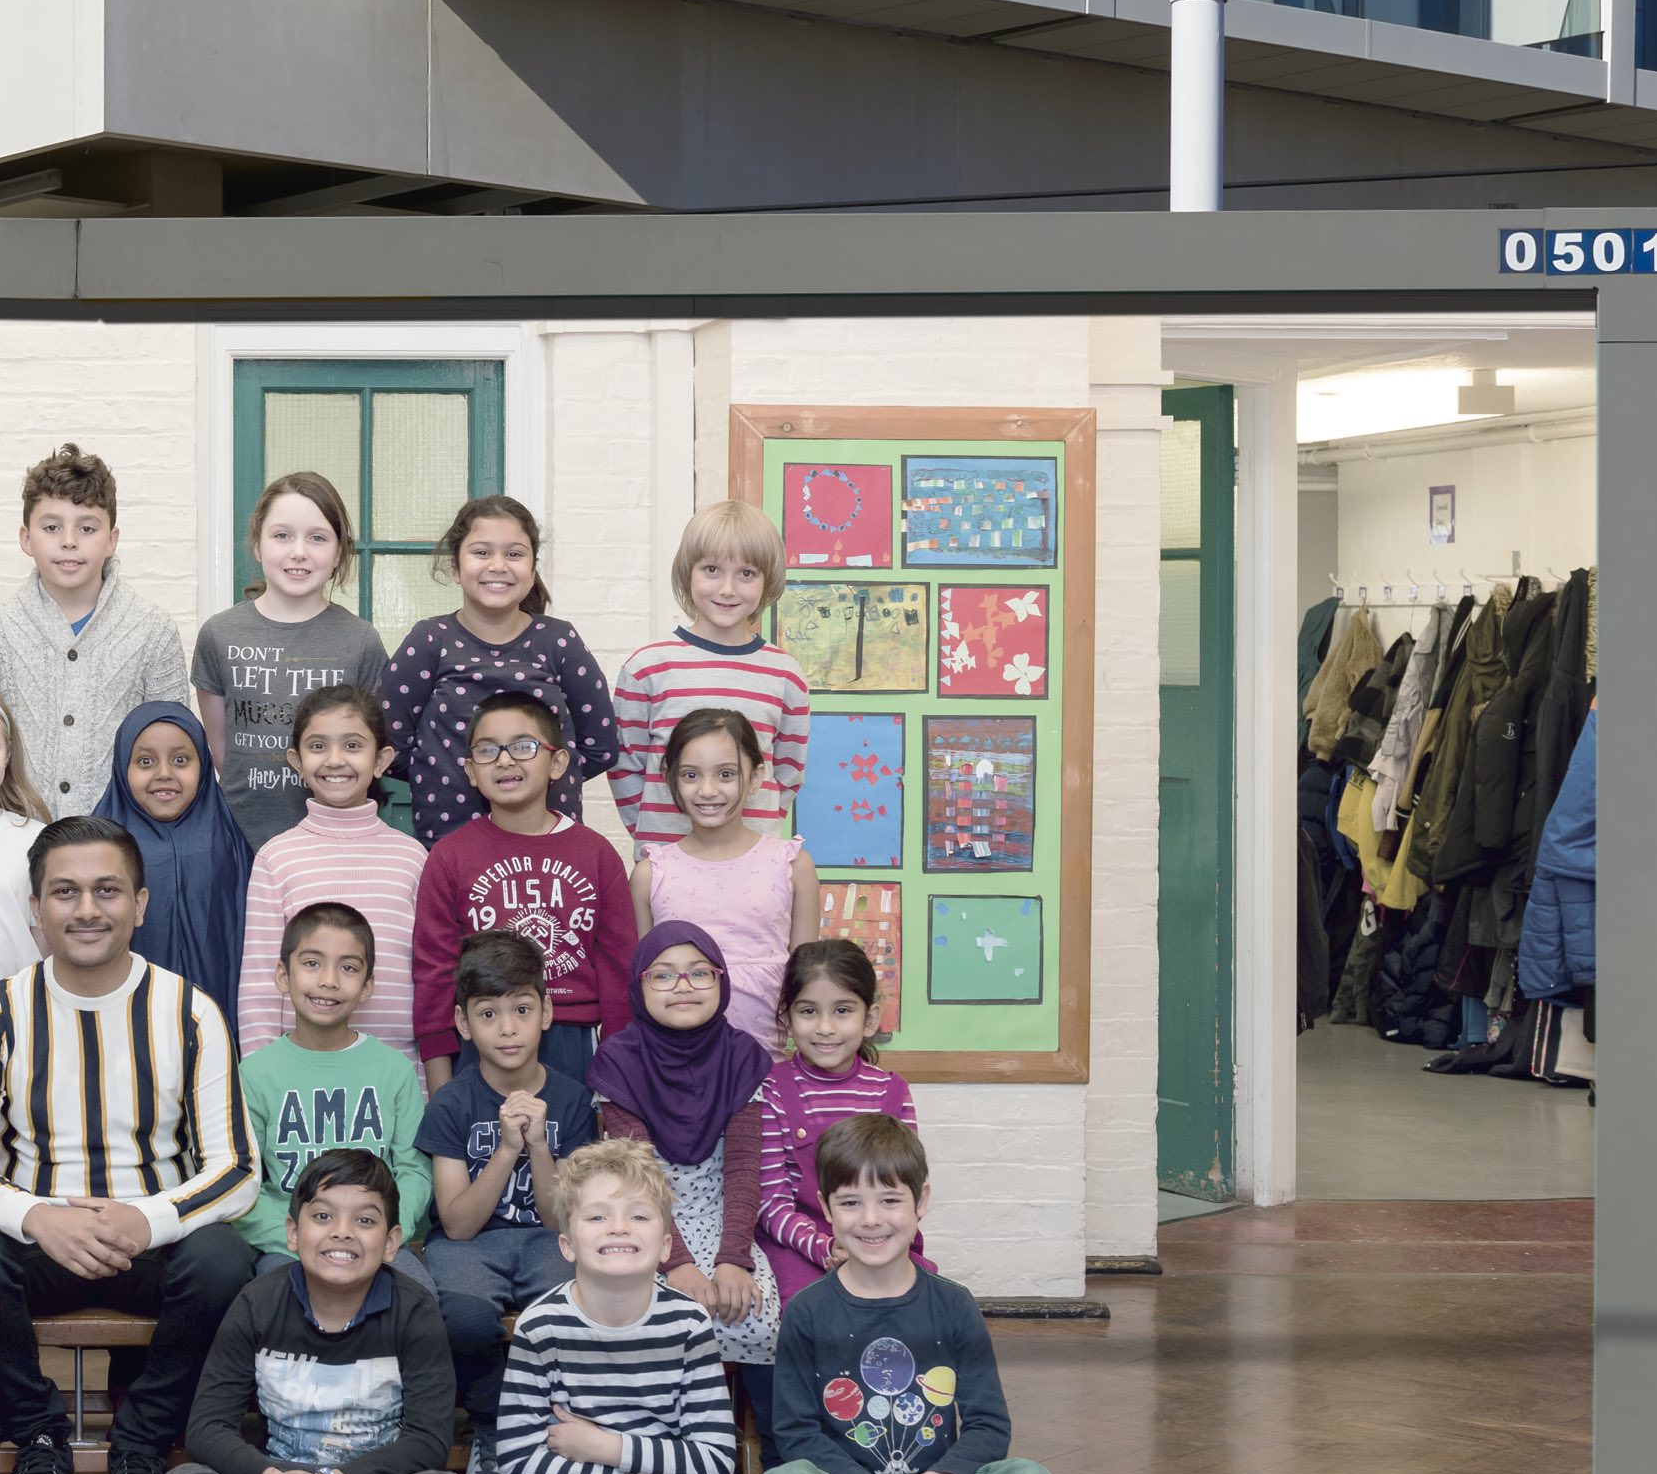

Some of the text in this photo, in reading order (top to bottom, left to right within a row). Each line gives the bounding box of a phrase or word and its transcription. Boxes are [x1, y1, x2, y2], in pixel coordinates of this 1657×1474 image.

[227, 645, 285, 662] DON'T
[231, 665, 345, 696] LET THE
[256, 734, 289, 749] YOU
[247, 767, 281, 790] Harry
[468, 856, 597, 903] SUPERIOR QUALITY
[467, 905, 596, 932] 19 65
[275, 1085, 384, 1145] AMA
